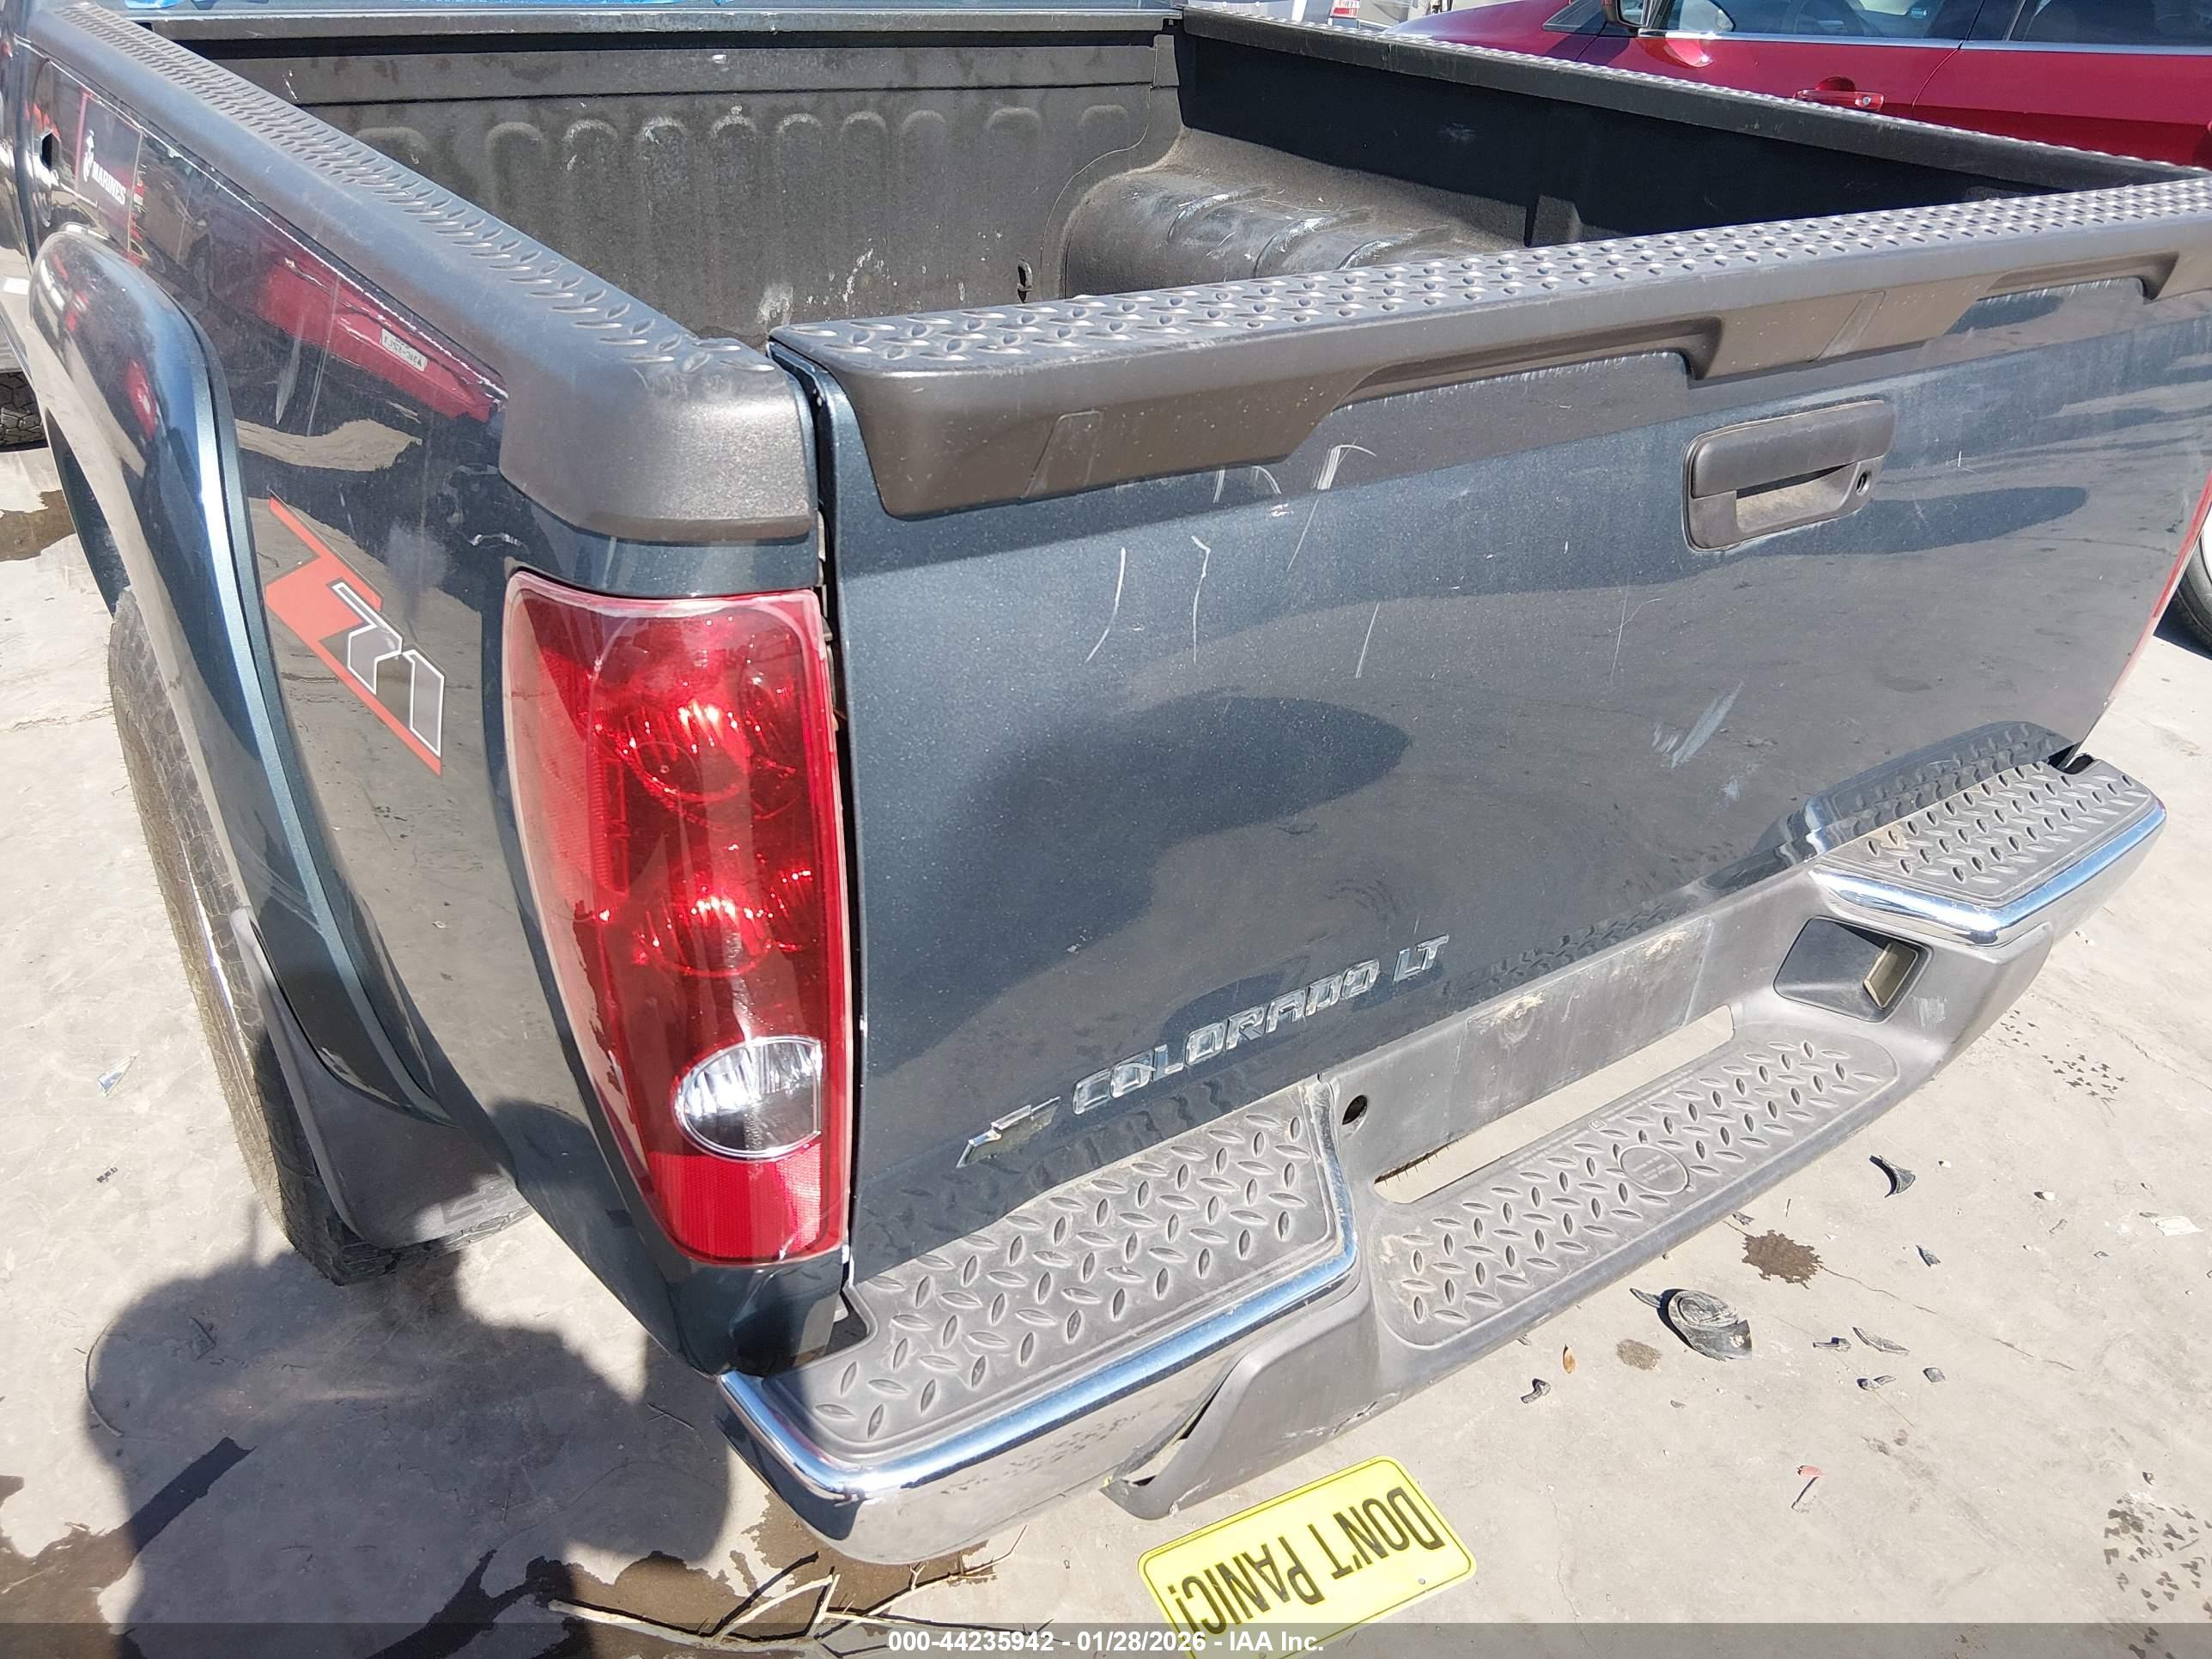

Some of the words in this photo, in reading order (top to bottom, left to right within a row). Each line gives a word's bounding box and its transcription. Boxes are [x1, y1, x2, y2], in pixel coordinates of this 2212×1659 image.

[91, 161, 127, 206] MARINES
[1072, 957, 1381, 1115] COLORADO
[1392, 933, 1449, 983] LT
[1306, 1486, 1447, 1580] DON'T
[1167, 1535, 1326, 1642] PANIC!
